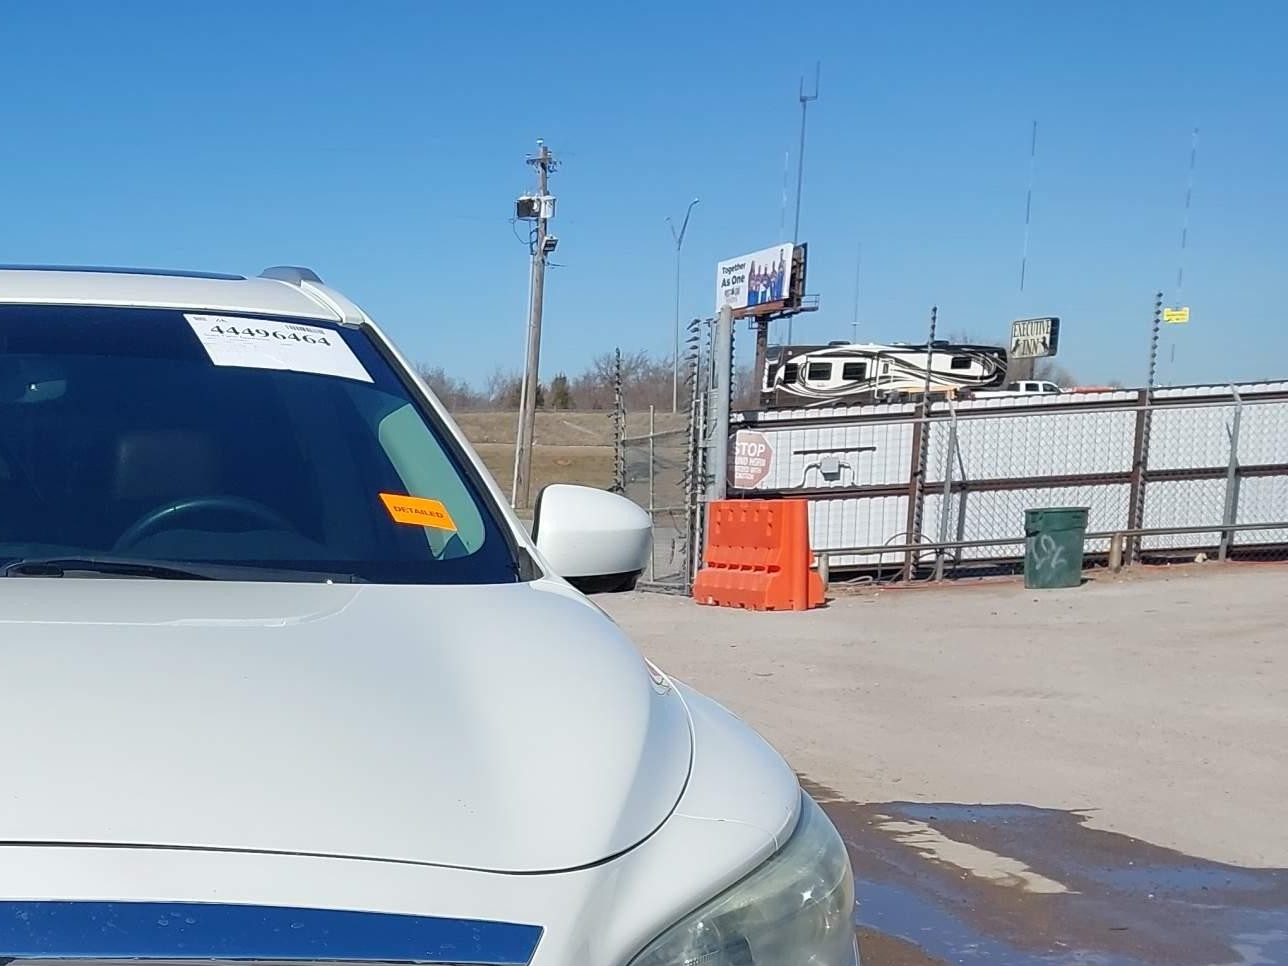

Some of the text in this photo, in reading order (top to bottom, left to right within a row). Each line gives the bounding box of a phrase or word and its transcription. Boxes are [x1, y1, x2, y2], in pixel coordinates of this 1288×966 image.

[722, 263, 746, 275] Together
[721, 275, 746, 288] As One
[210, 325, 331, 347] 44496464
[1012, 320, 1050, 337] EXECUTIVE
[1022, 338, 1038, 356] INN
[732, 442, 766, 457] STOP
[393, 505, 444, 519] DETAILED
